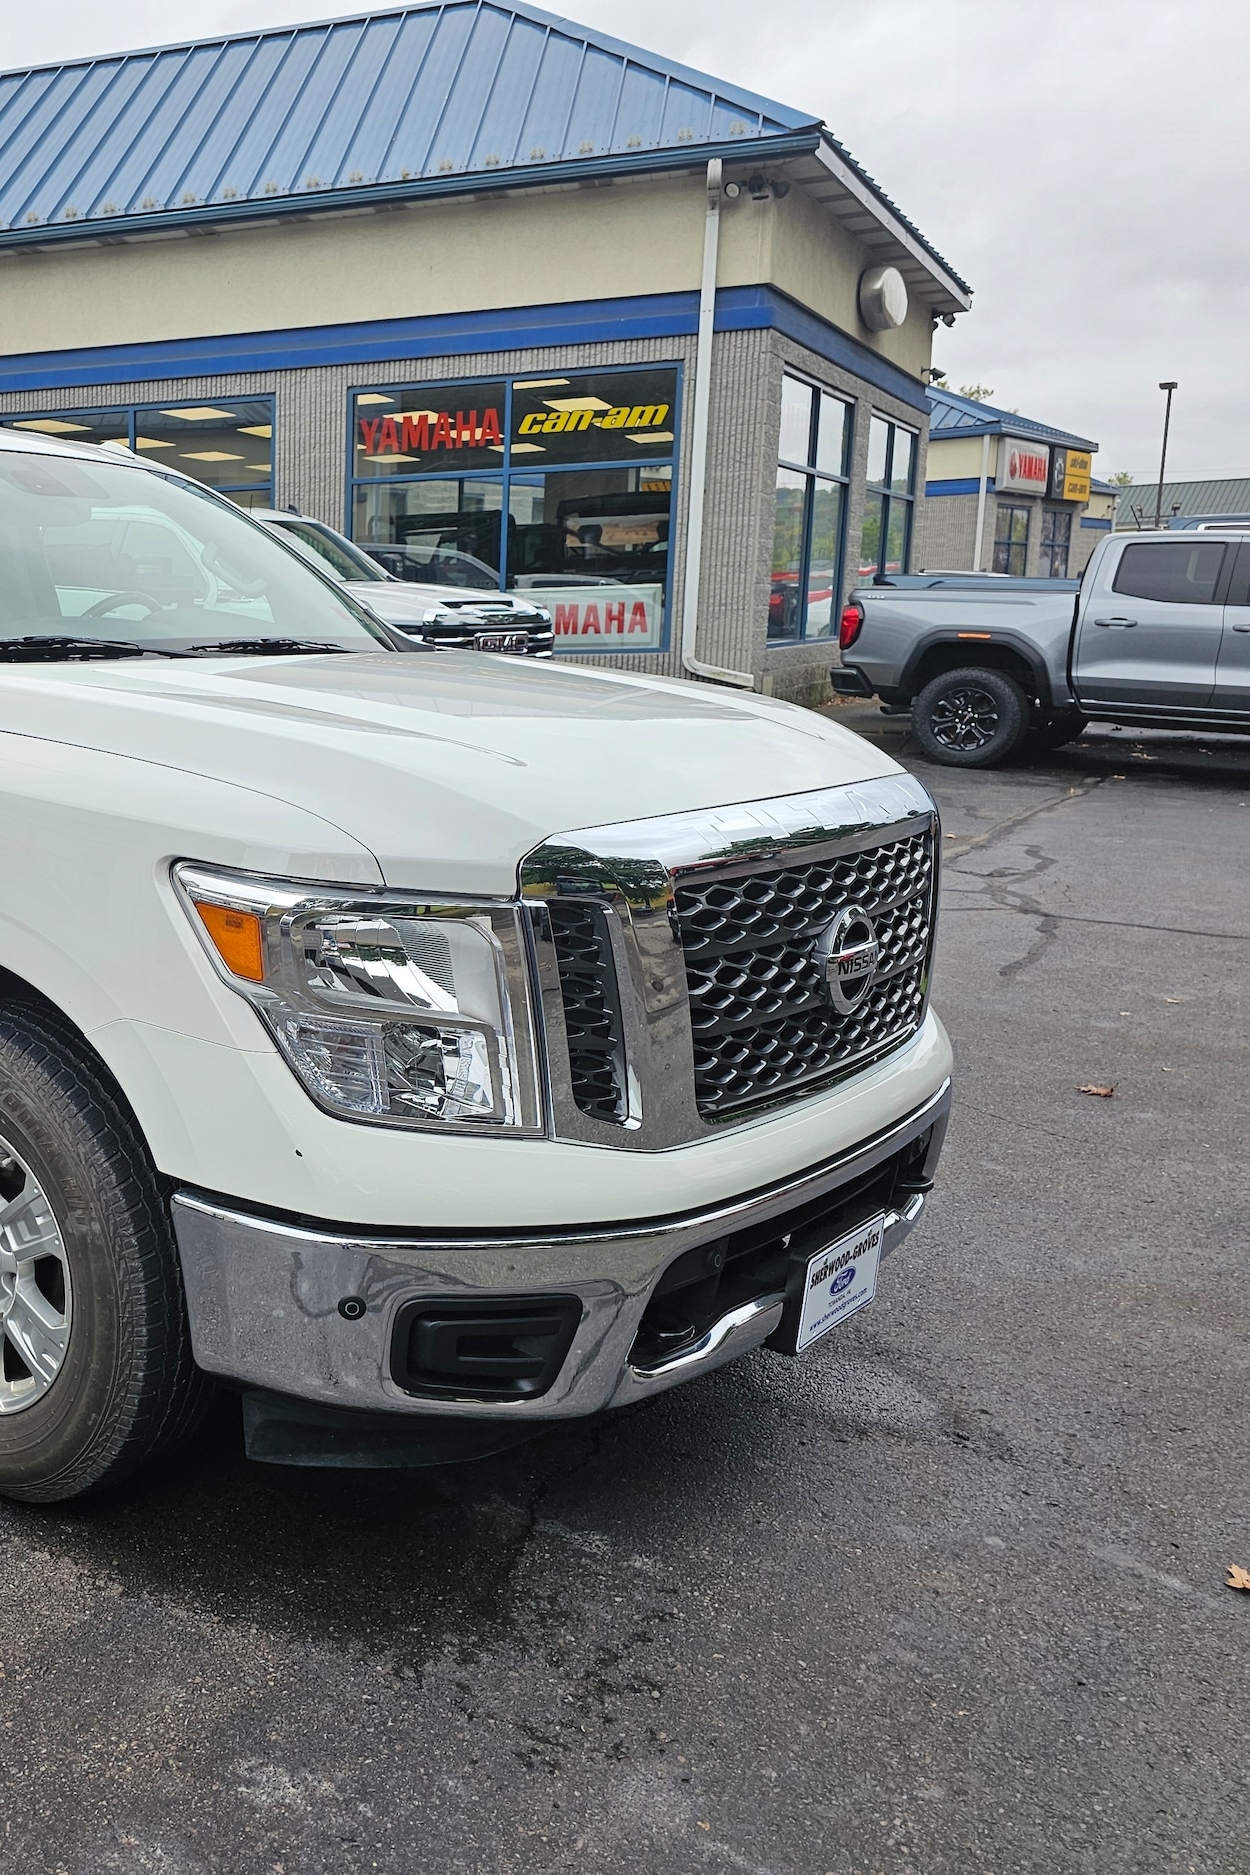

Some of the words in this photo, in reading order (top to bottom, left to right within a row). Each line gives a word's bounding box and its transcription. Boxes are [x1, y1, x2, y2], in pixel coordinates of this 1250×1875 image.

[360, 408, 502, 455] YAMAHA
[517, 403, 670, 435] can-am
[1019, 453, 1046, 482] YAMAHA
[544, 601, 649, 636] MAHA
[810, 1230, 880, 1289] SHERWOOD-GROVES
